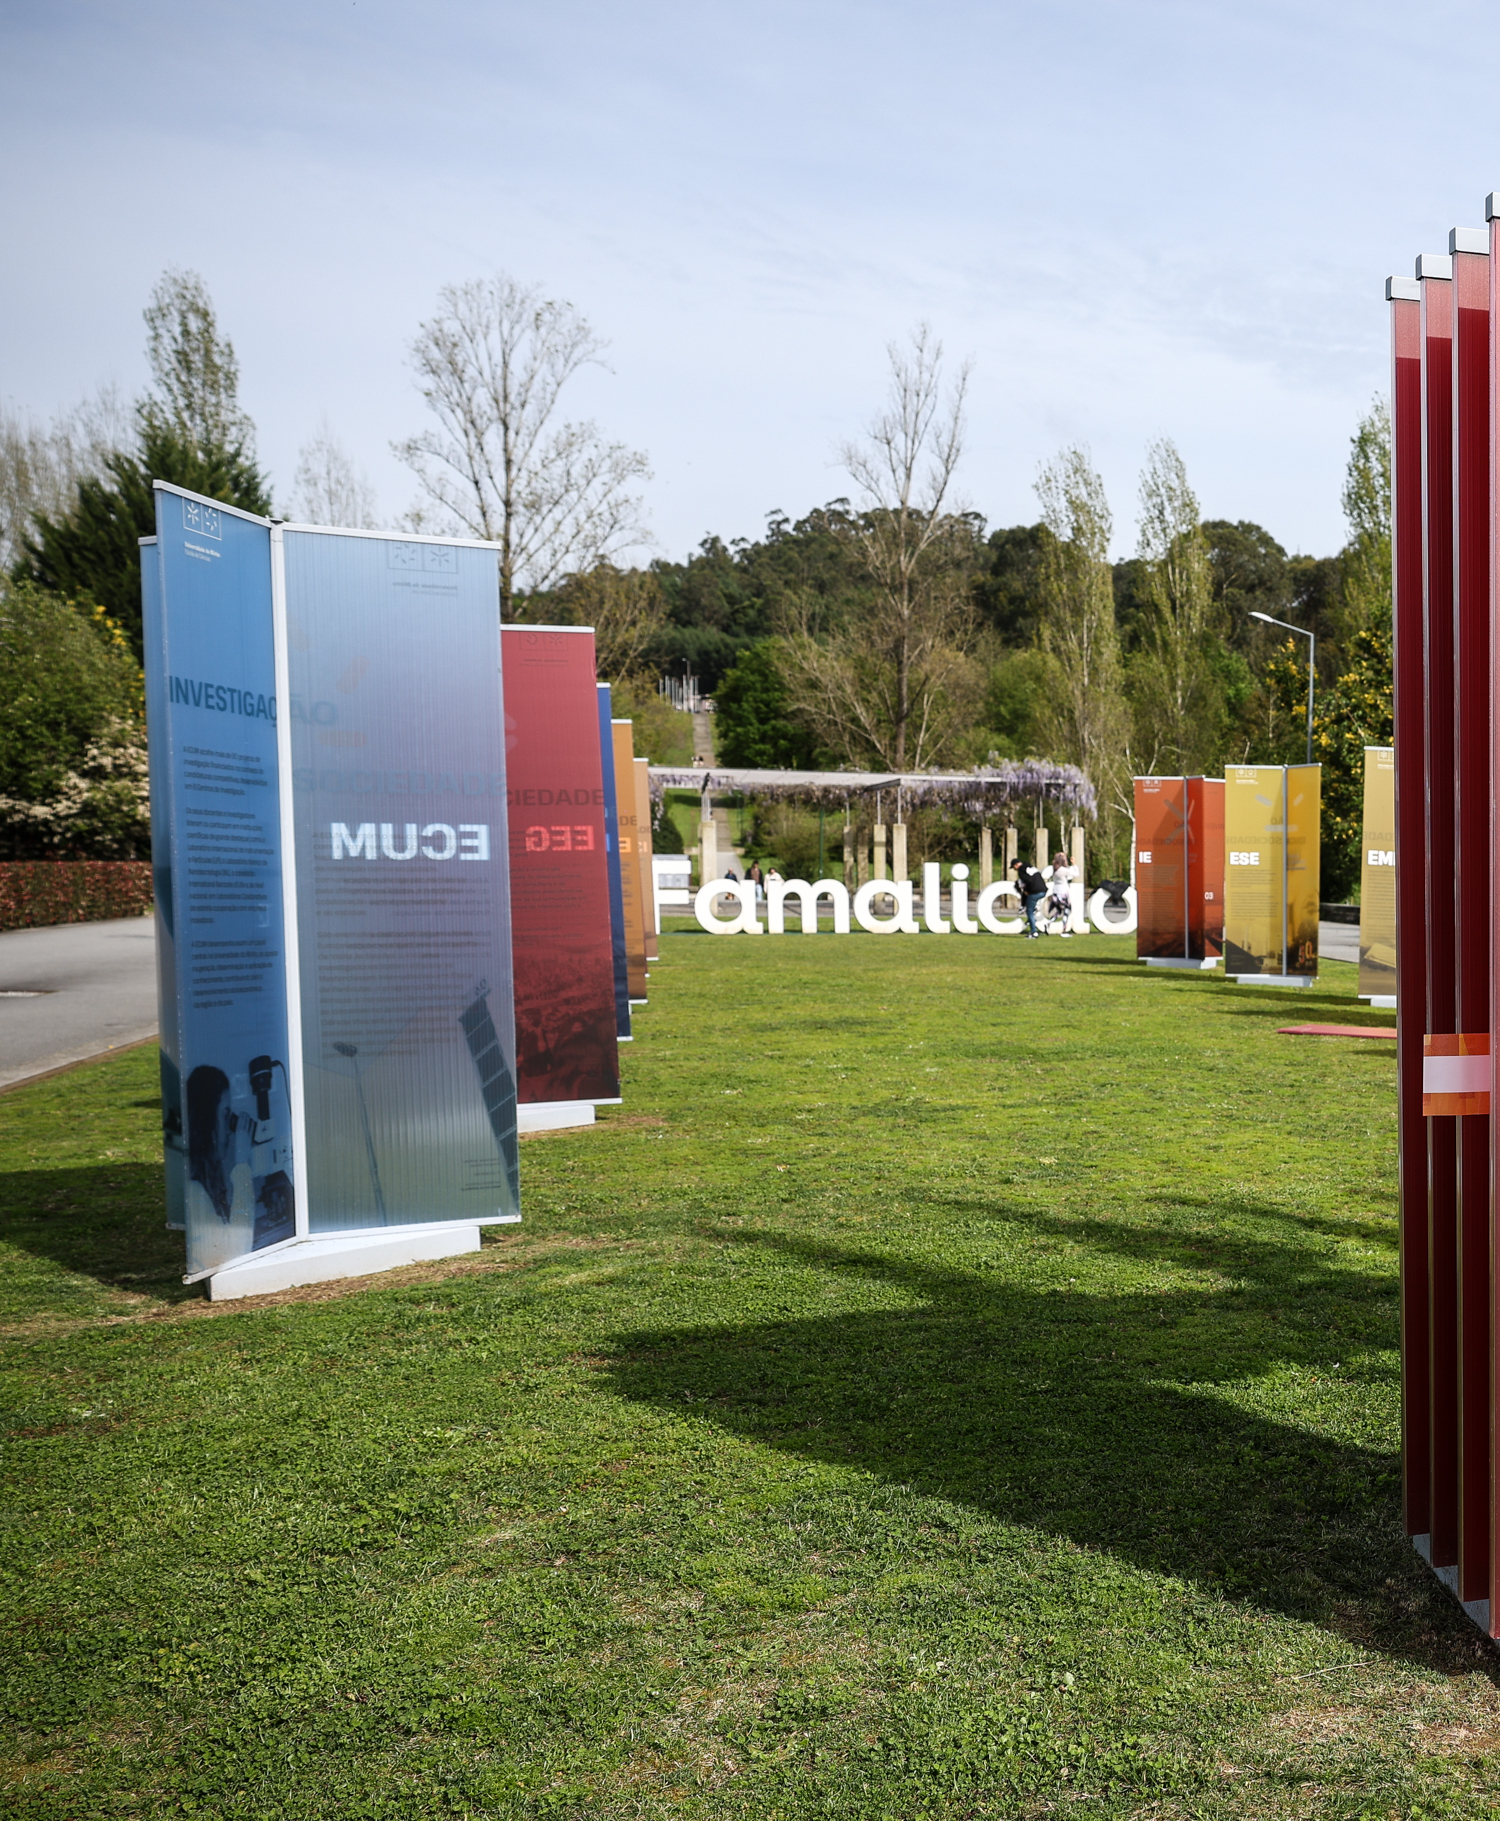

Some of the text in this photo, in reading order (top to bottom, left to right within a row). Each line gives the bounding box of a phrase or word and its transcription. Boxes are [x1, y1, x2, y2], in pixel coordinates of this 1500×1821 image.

[1138, 851, 1152, 863] IE
[1229, 852, 1260, 865] ESE
[1367, 850, 1395, 866] EM
